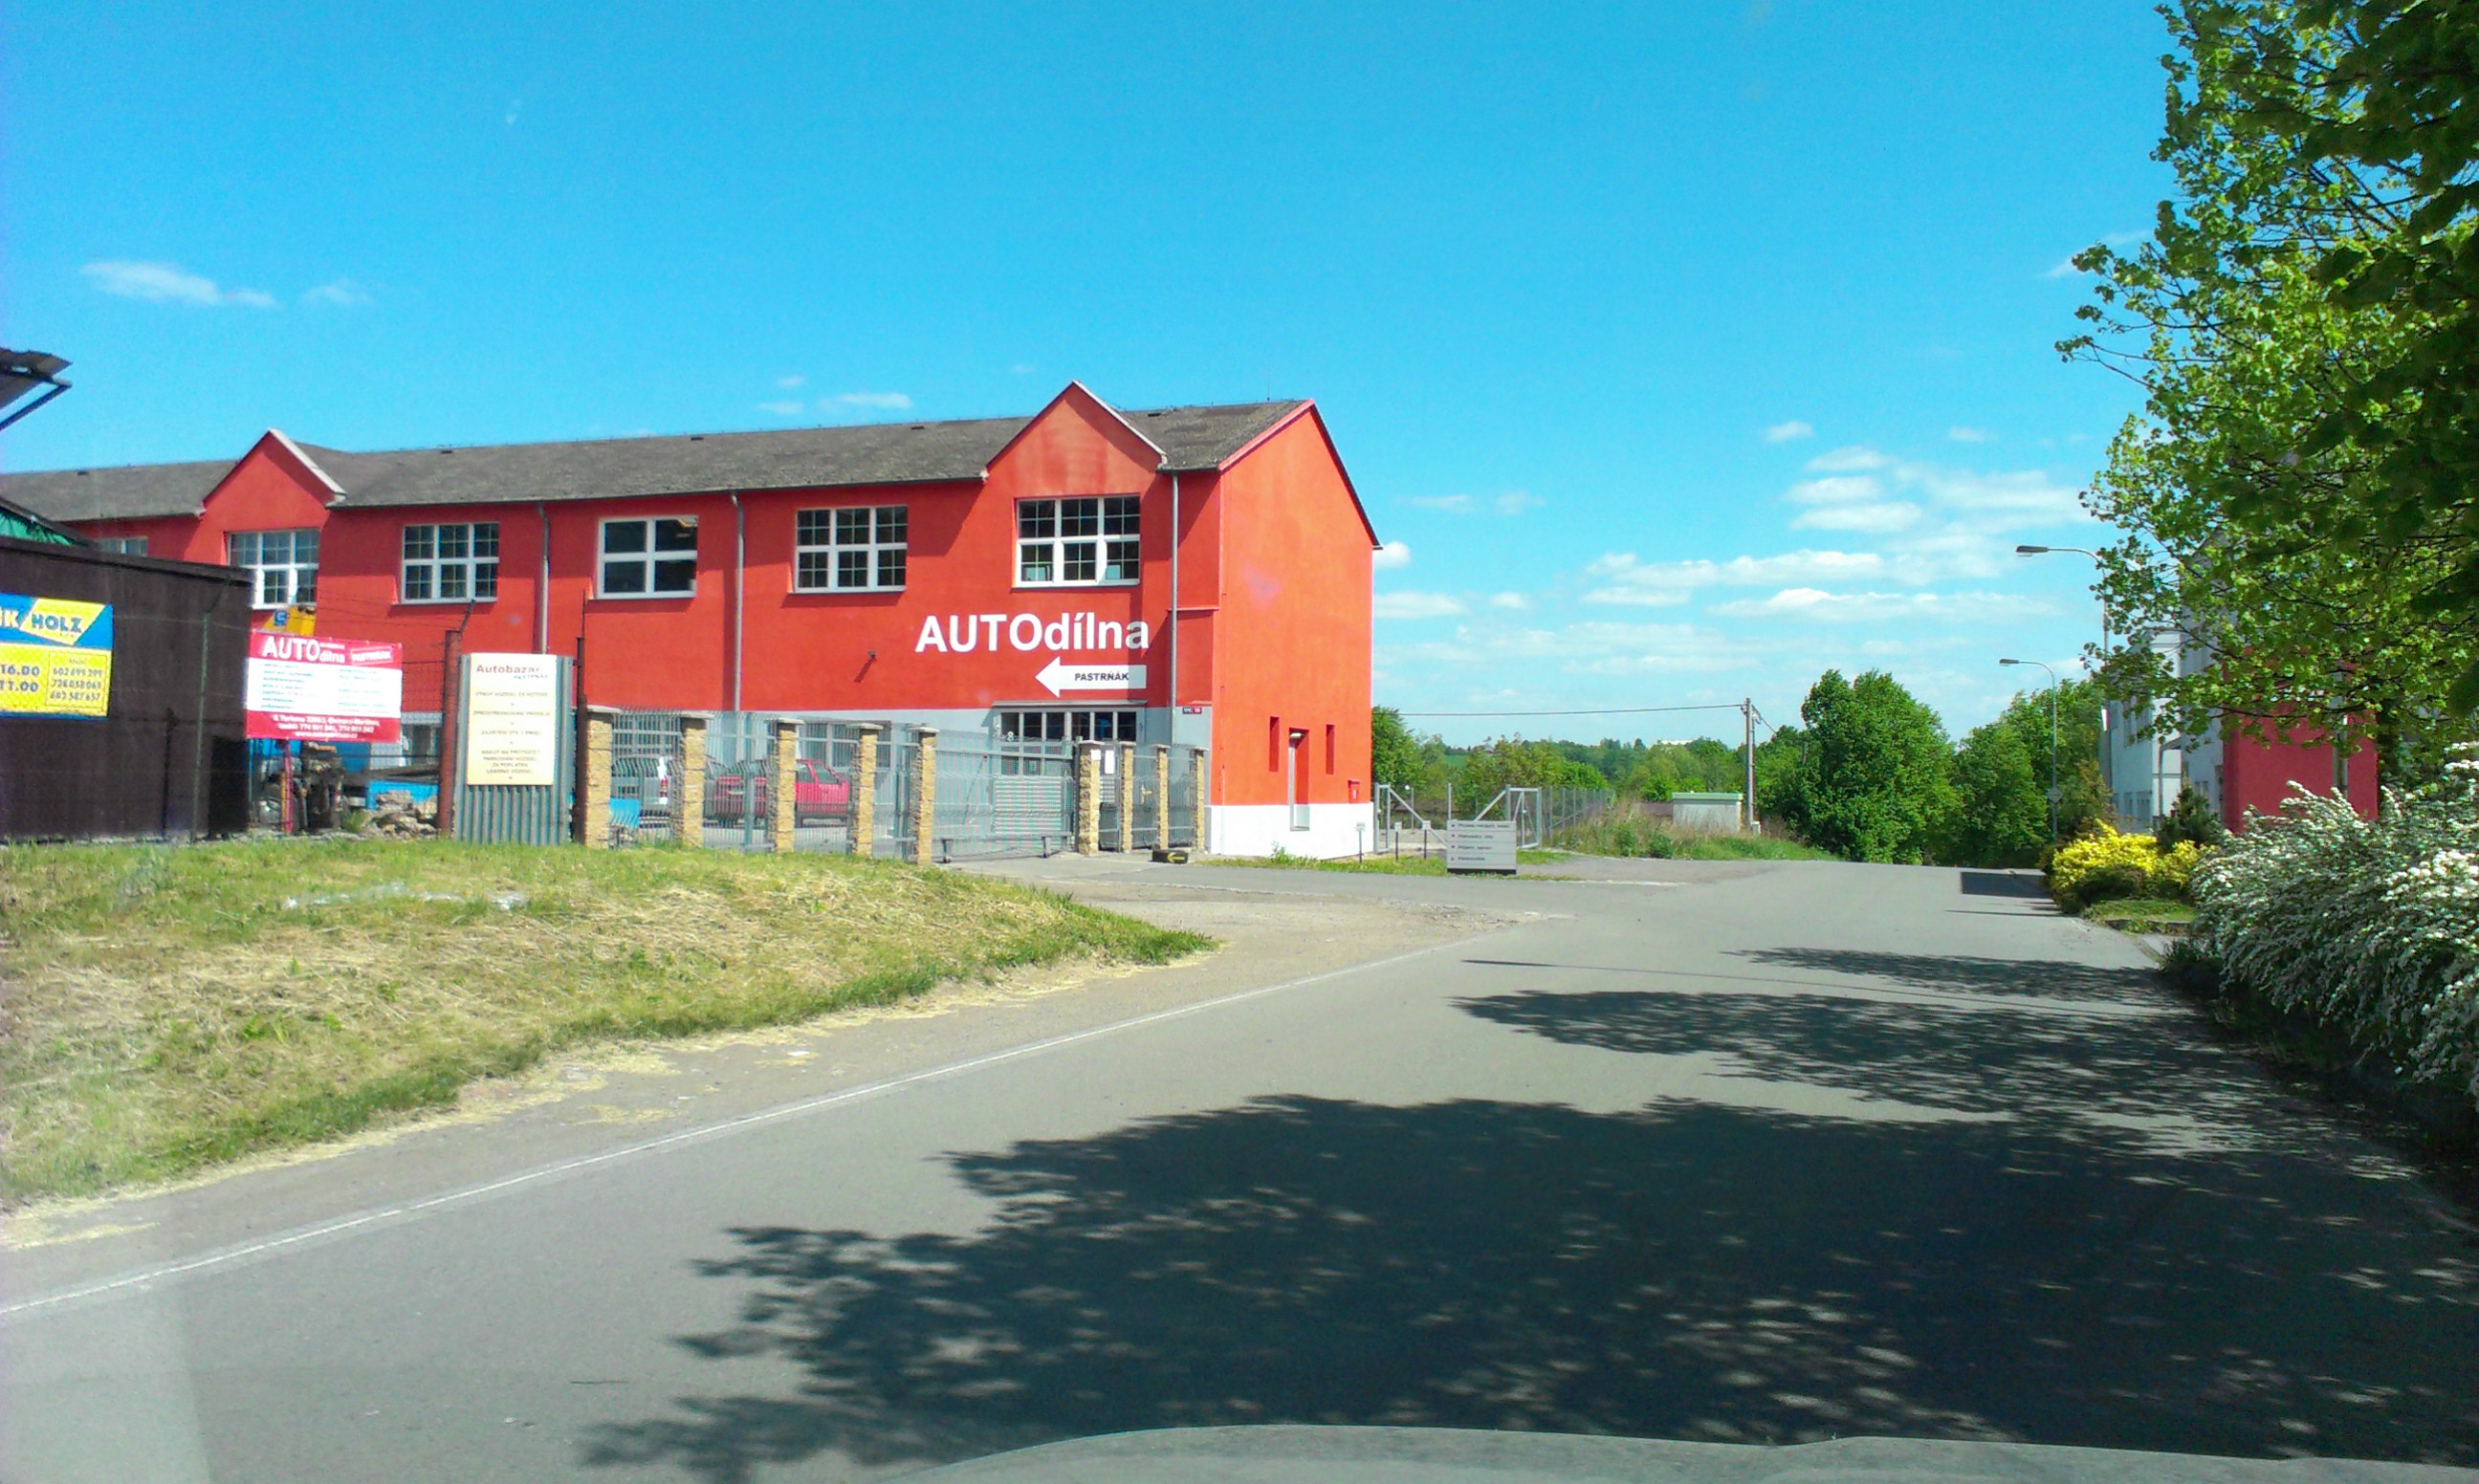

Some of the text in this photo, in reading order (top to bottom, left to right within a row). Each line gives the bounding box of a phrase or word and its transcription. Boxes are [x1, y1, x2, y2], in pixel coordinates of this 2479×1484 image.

[0, 605, 82, 633] K HOLZ
[915, 612, 1149, 652] AUTOdílna
[476, 665, 539, 673] Autobazar
